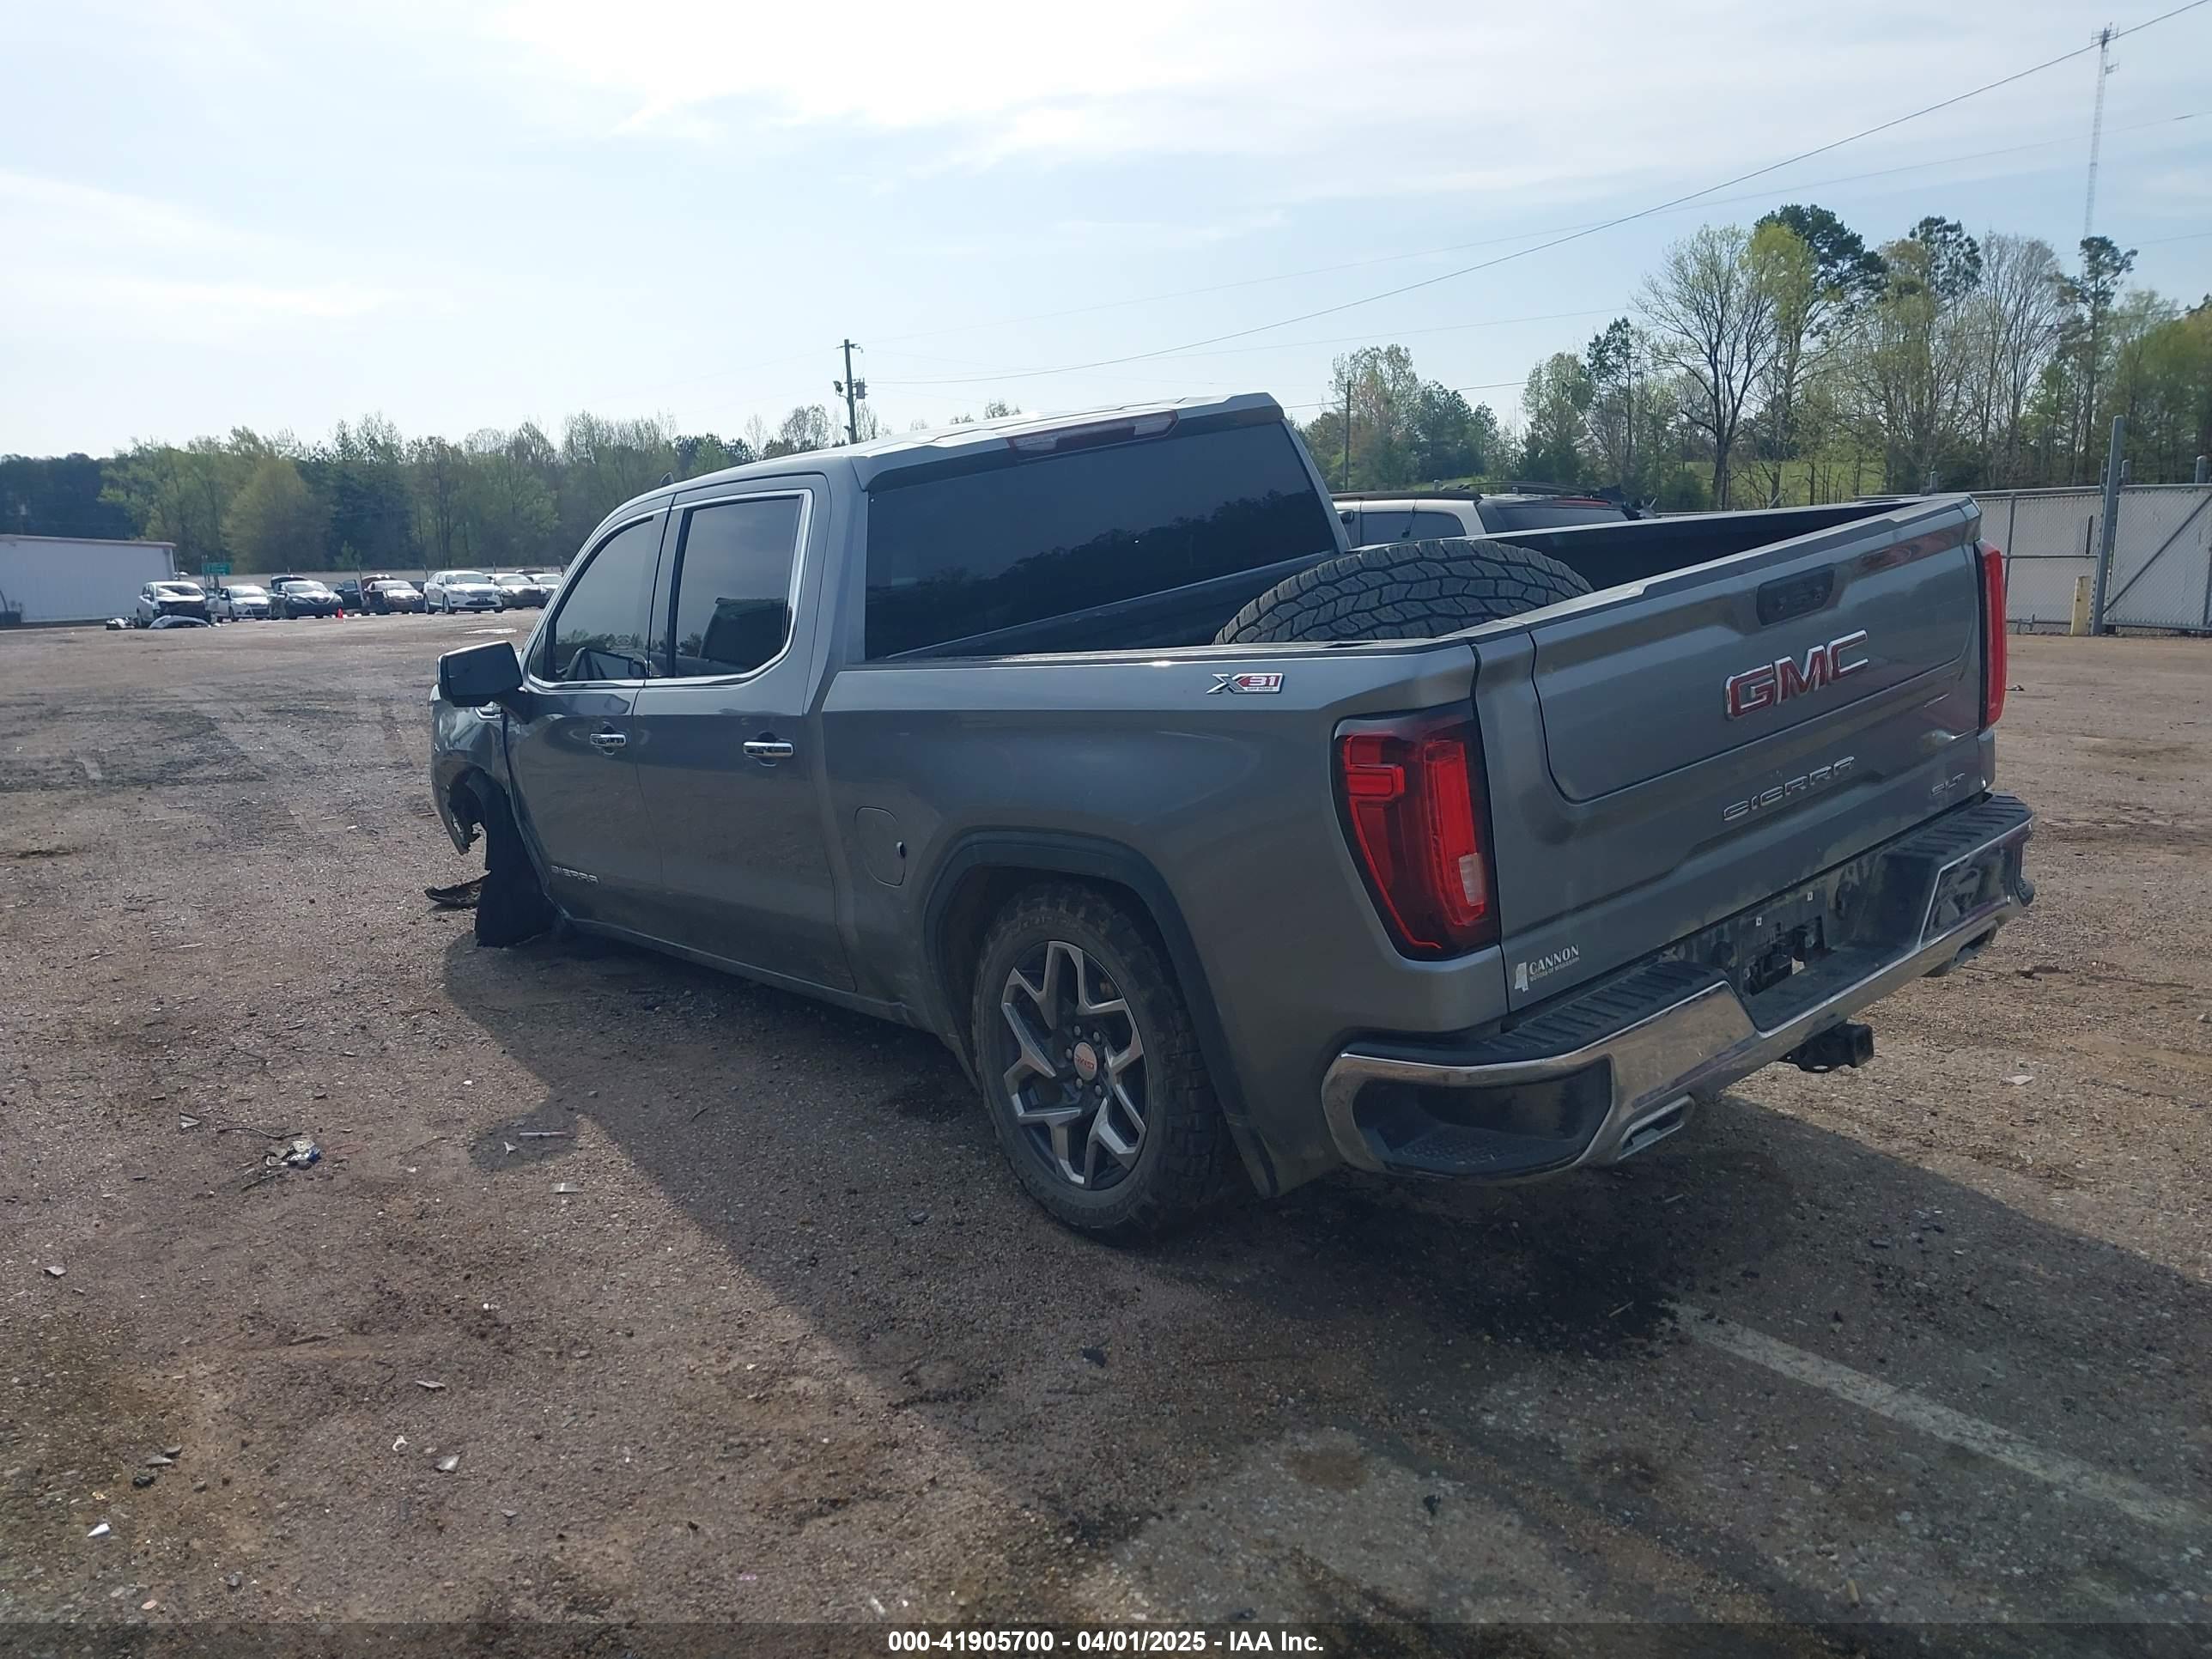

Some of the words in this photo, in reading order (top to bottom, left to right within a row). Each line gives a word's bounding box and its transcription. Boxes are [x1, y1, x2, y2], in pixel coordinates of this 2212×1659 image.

[1206, 672, 1284, 694] X31
[1725, 629, 1869, 720] GMC
[1723, 756, 1856, 822] SIERRA
[1930, 772, 1966, 798] SLT
[1529, 944, 1579, 975] CANNON
